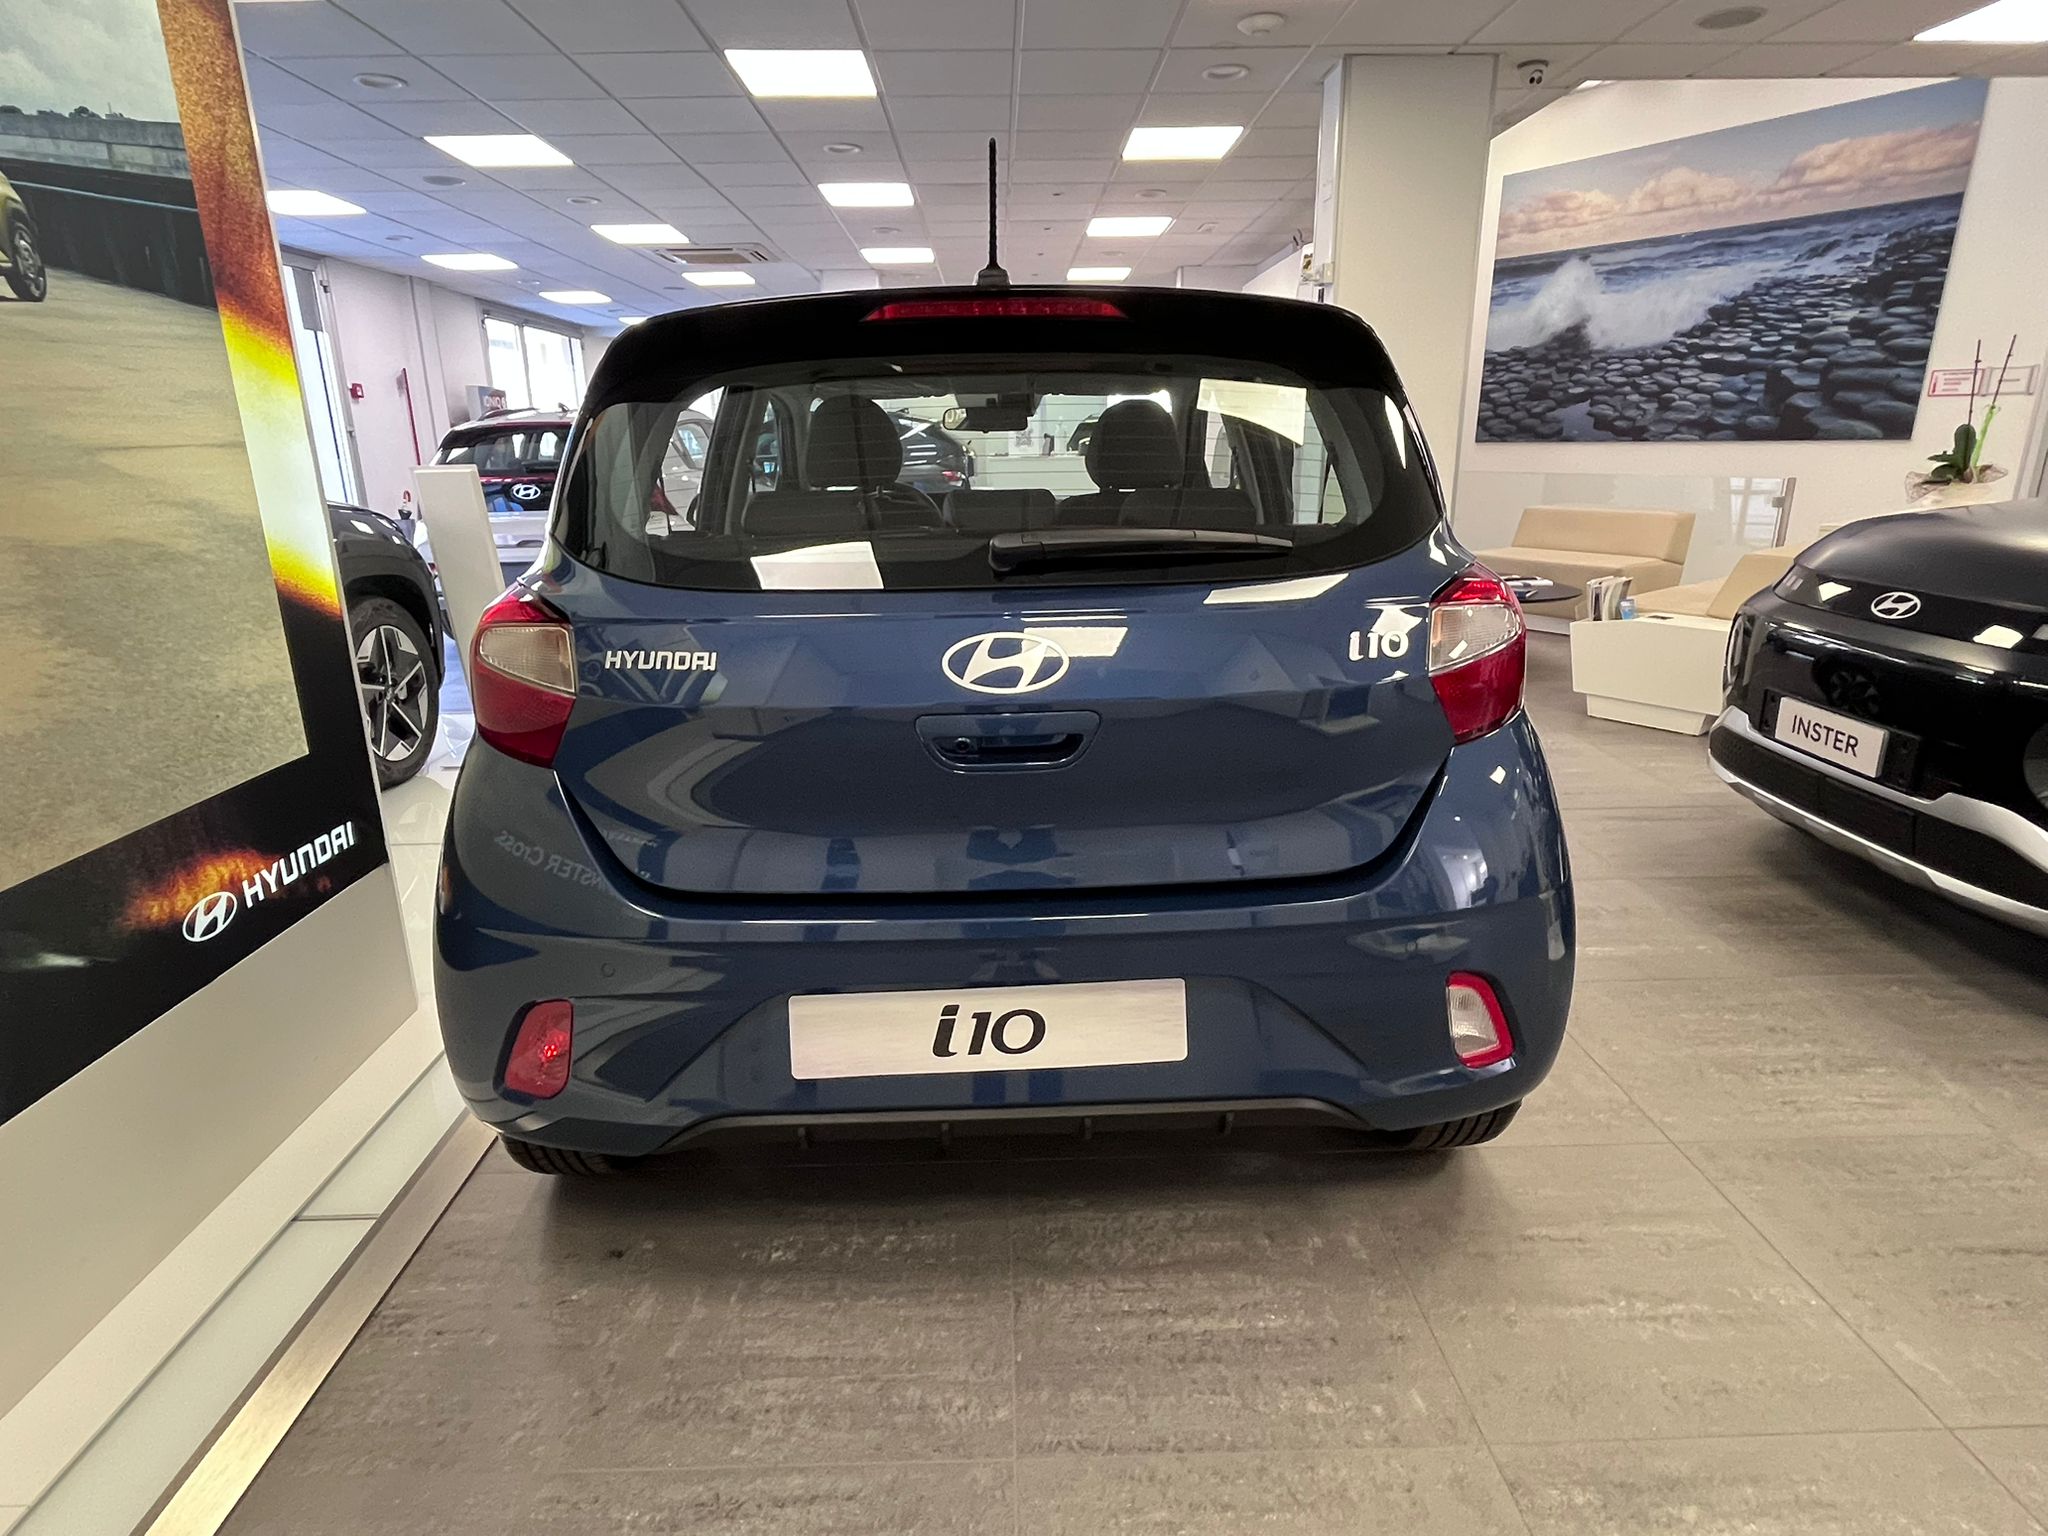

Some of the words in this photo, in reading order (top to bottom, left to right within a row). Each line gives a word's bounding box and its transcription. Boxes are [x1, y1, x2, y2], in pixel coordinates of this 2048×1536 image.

[604, 650, 718, 671] HYUNDAI
[1348, 631, 1409, 661] i10
[1791, 714, 1859, 758] INSTER
[242, 821, 355, 909] HYUNDAI
[932, 1004, 1046, 1058] i10
